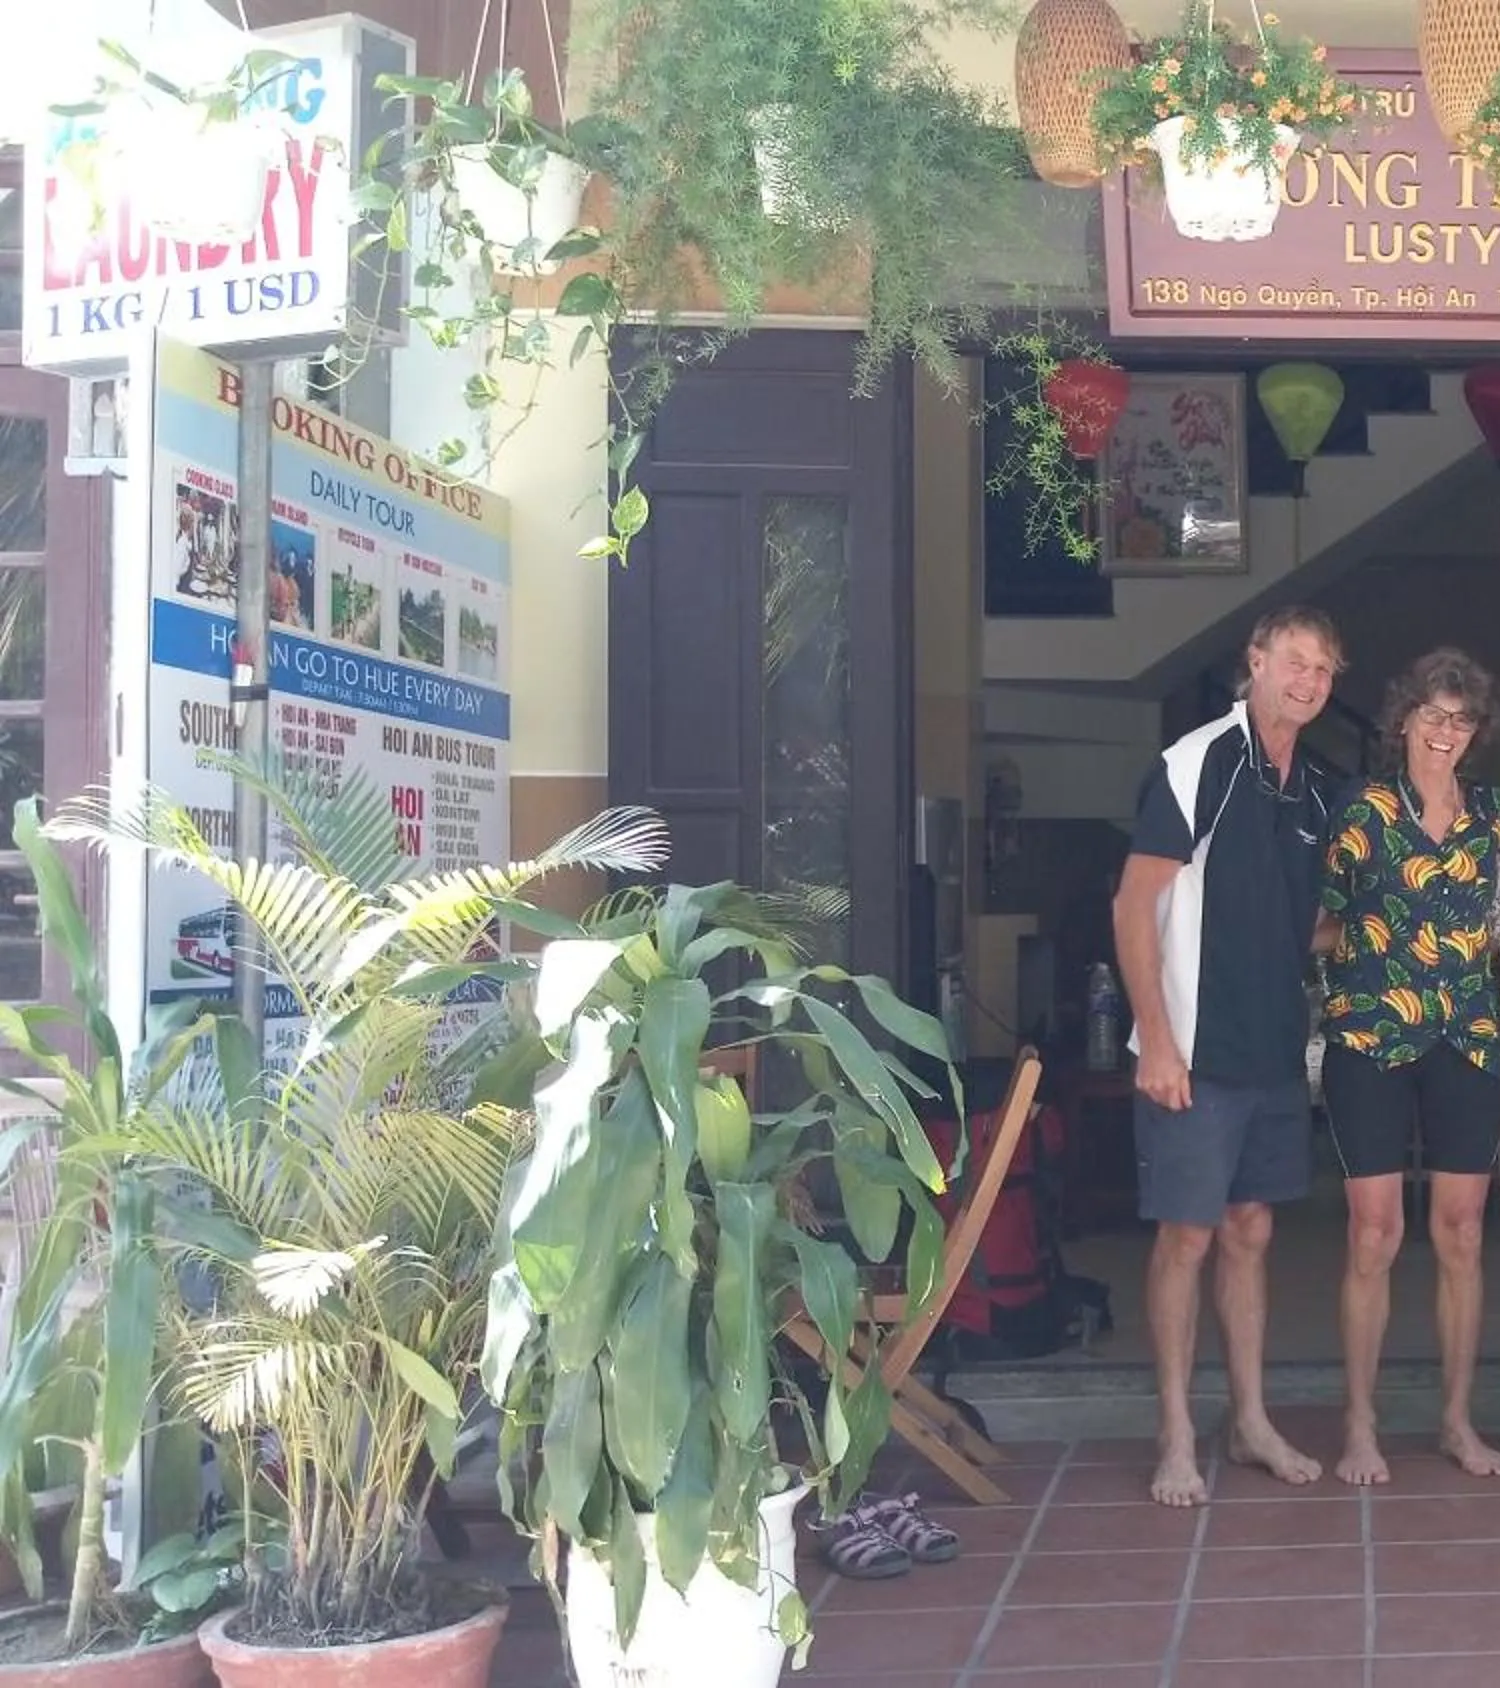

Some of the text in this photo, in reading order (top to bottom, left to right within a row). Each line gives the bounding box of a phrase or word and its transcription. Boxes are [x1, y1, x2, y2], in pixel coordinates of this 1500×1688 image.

[47, 305, 63, 338] 1
[81, 293, 144, 335] KG
[188, 287, 206, 321] 1
[223, 270, 320, 317] USD
[1142, 279, 1189, 304] 138
[1351, 287, 1388, 311] Tp.
[1445, 289, 1476, 307] An
[217, 366, 375, 471] BOKING
[311, 469, 415, 538] DAILY TOUR
[295, 648, 327, 677] GO
[332, 655, 359, 685] TO
[364, 664, 400, 696] HUE
[404, 676, 451, 708] EVERY
[454, 688, 484, 716] DAY
[180, 700, 237, 751] SOUTH
[383, 725, 407, 755] HOI
[412, 732, 433, 758] AN
[435, 736, 462, 765] BUS
[391, 786, 424, 821] HOI
